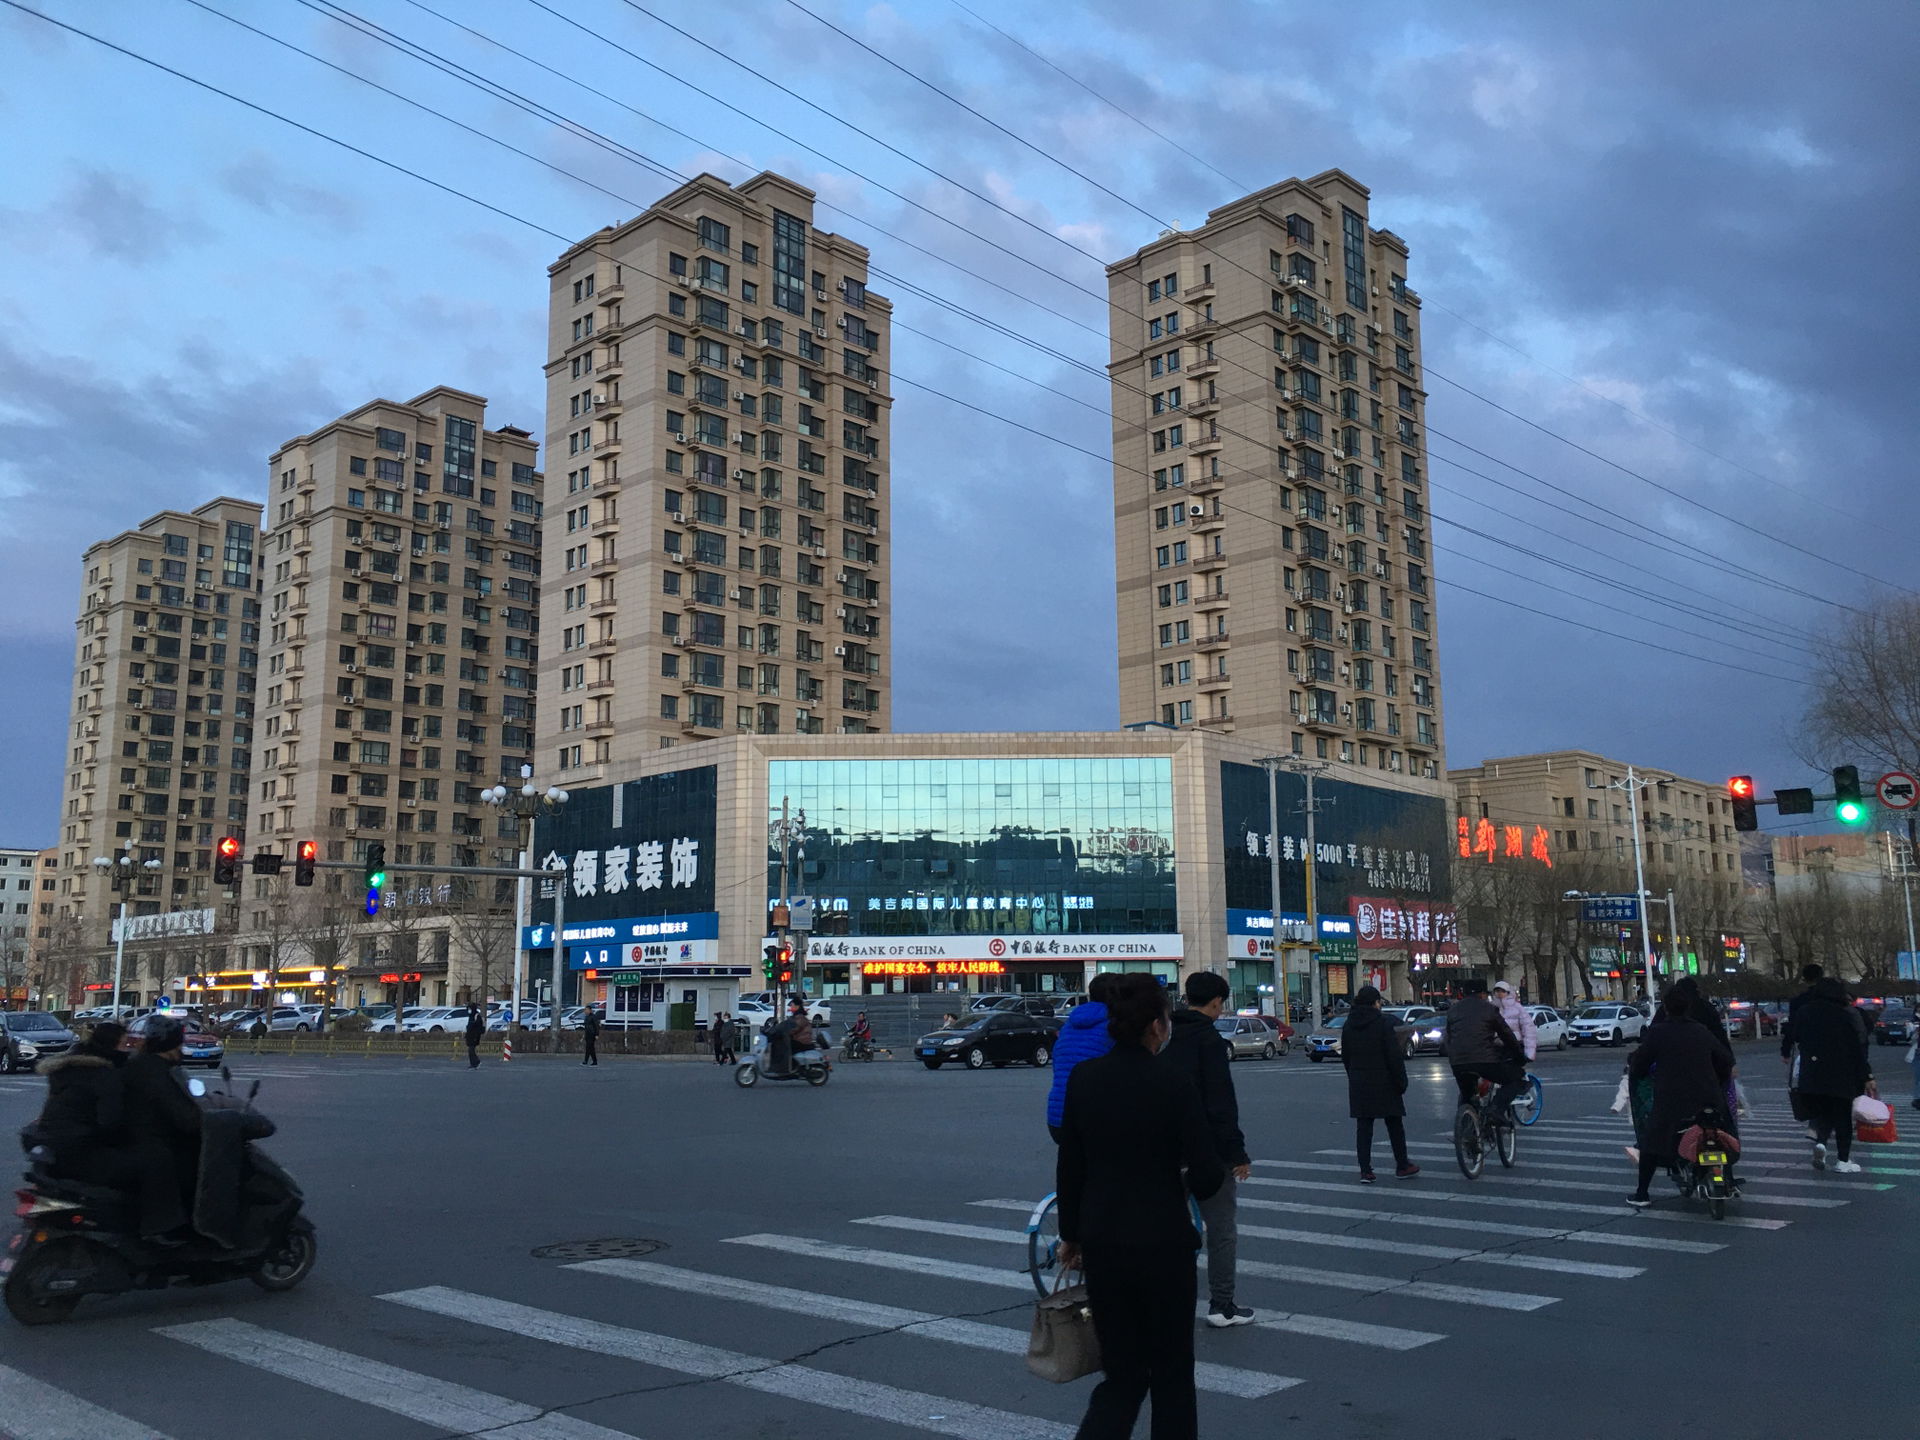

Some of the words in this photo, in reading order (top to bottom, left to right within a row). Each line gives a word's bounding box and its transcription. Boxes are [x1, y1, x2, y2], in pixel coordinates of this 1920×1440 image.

[572, 836, 699, 898] 领家装饰
[867, 896, 1045, 911] 美吉姆国际儿童教育中心
[807, 941, 850, 957] 国银行
[852, 945, 885, 955] BANK
[890, 945, 904, 954] OF
[907, 945, 945, 955] CHINA
[1011, 939, 1060, 955] 中国银行
[1062, 943, 1097, 953] BANK
[1100, 943, 1115, 953] OF
[1118, 943, 1156, 953] CHINA
[582, 950, 608, 965] 入口
